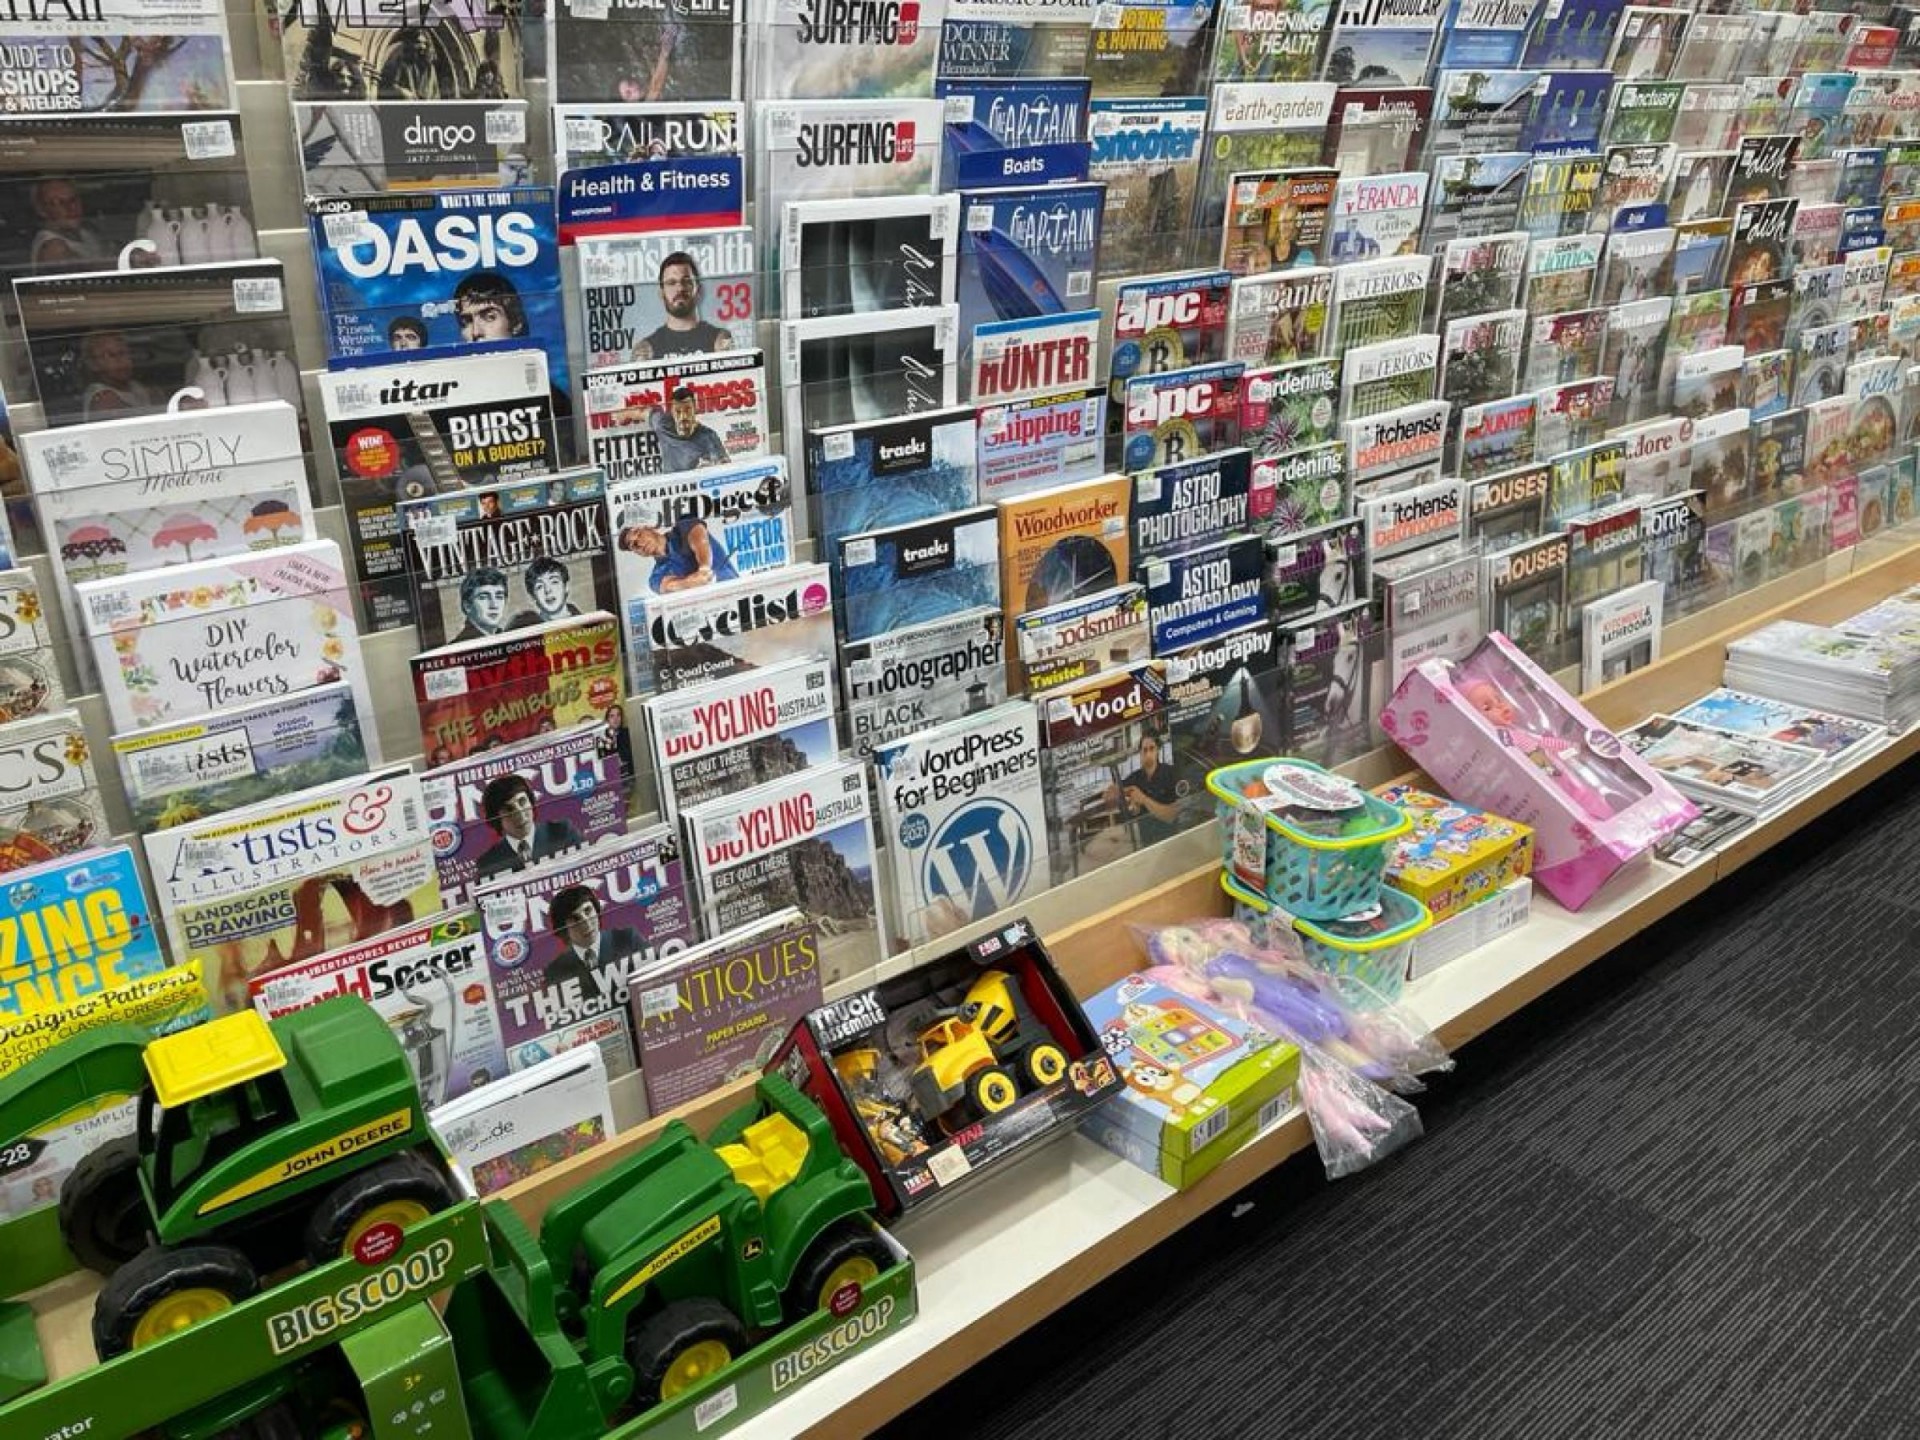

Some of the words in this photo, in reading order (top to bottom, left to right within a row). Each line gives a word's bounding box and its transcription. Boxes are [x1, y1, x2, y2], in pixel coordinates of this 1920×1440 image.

[797, 1, 899, 44] SURFING
[945, 23, 1012, 43] DOUBLE
[0, 44, 47, 68] UIDE
[53, 44, 76, 68] TO
[943, 43, 1010, 62] WINNER
[1259, 36, 1318, 54] HEALTH
[0, 69, 80, 95] SHOPS
[20, 95, 82, 110] ATELIERS
[404, 114, 476, 151] dingo
[796, 121, 896, 168] SURFING
[1003, 156, 1046, 175] Boats
[571, 175, 635, 198] Health
[641, 172, 654, 192] &
[660, 171, 731, 191] Fitness
[336, 211, 540, 279] OASIS
[586, 284, 635, 310] BUILD
[716, 282, 752, 322] 33
[335, 314, 359, 324] The
[337, 324, 376, 337] Finest
[588, 307, 625, 332] ANY
[589, 327, 636, 353] BODY
[587, 374, 620, 390] HOW
[621, 371, 636, 384] TO
[638, 368, 653, 381] BE
[449, 405, 543, 450] BURST
[101, 435, 243, 481] SIMPLY
[454, 450, 473, 468] ON
[477, 449, 487, 464] A
[489, 438, 547, 463] BUDGET?
[592, 430, 660, 464] FITTER
[879, 436, 927, 461] tracks
[614, 482, 698, 505] AUSTRALIAN
[1171, 471, 1221, 511] ASTRO
[539, 503, 605, 559] ROCK
[723, 516, 785, 554] VIKTOR
[1015, 499, 1120, 538] Woodworker
[1138, 492, 1248, 547] PHOTOGRAPHY
[903, 539, 950, 564] tracks
[1593, 525, 1638, 555] DESIGN
[736, 545, 786, 574] HOVLAND
[1182, 558, 1231, 597] ASTRO
[206, 616, 250, 647] DIY
[1165, 615, 1213, 641] Computers
[1215, 614, 1221, 626] &
[1223, 602, 1258, 621] Gaming
[1601, 615, 1653, 646] BATHROOMS
[170, 632, 300, 684] Watercolor
[419, 658, 446, 672] FREE
[676, 665, 701, 680] Cool
[703, 657, 736, 674] Coast
[1029, 662, 1086, 690] Twisted
[197, 674, 290, 710] Flowers
[777, 692, 826, 718] AUSTRALIA
[1071, 683, 1142, 727] Wood
[433, 716, 476, 746] THE
[483, 680, 582, 728] BAMBOOS
[855, 700, 926, 736] BLACK
[858, 735, 875, 757] &
[674, 766, 697, 782] GET
[697, 759, 716, 777] OUT
[719, 748, 751, 770] THERE
[894, 784, 929, 813] for
[931, 747, 1038, 801] Beginners
[342, 784, 393, 835] &
[816, 795, 864, 821] AUSTRALIA
[715, 871, 735, 888] GET
[738, 863, 757, 882] OUT
[182, 888, 290, 925] LANDSCAPE
[186, 902, 295, 940] DRAWING
[387, 932, 430, 953] REVIEW
[369, 940, 477, 1000] Soccer
[98, 968, 198, 1011] Patterns
[504, 975, 583, 1028] THE
[57, 1008, 123, 1039] CLASSIC
[123, 991, 190, 1025] DRESSES
[544, 987, 632, 1032] PSYCHO
[810, 989, 881, 1031] TRUCK
[818, 1007, 887, 1045] ASSEMBLE
[282, 1146, 335, 1177] JOHN
[338, 1117, 405, 1153] DEERE
[649, 1245, 680, 1275] JOHN
[680, 1221, 719, 1254] DEERE
[266, 1295, 338, 1356] BIG
[335, 1238, 455, 1324] SCOOP
[771, 1344, 816, 1394] BIG
[813, 1295, 895, 1364] SCOOP
